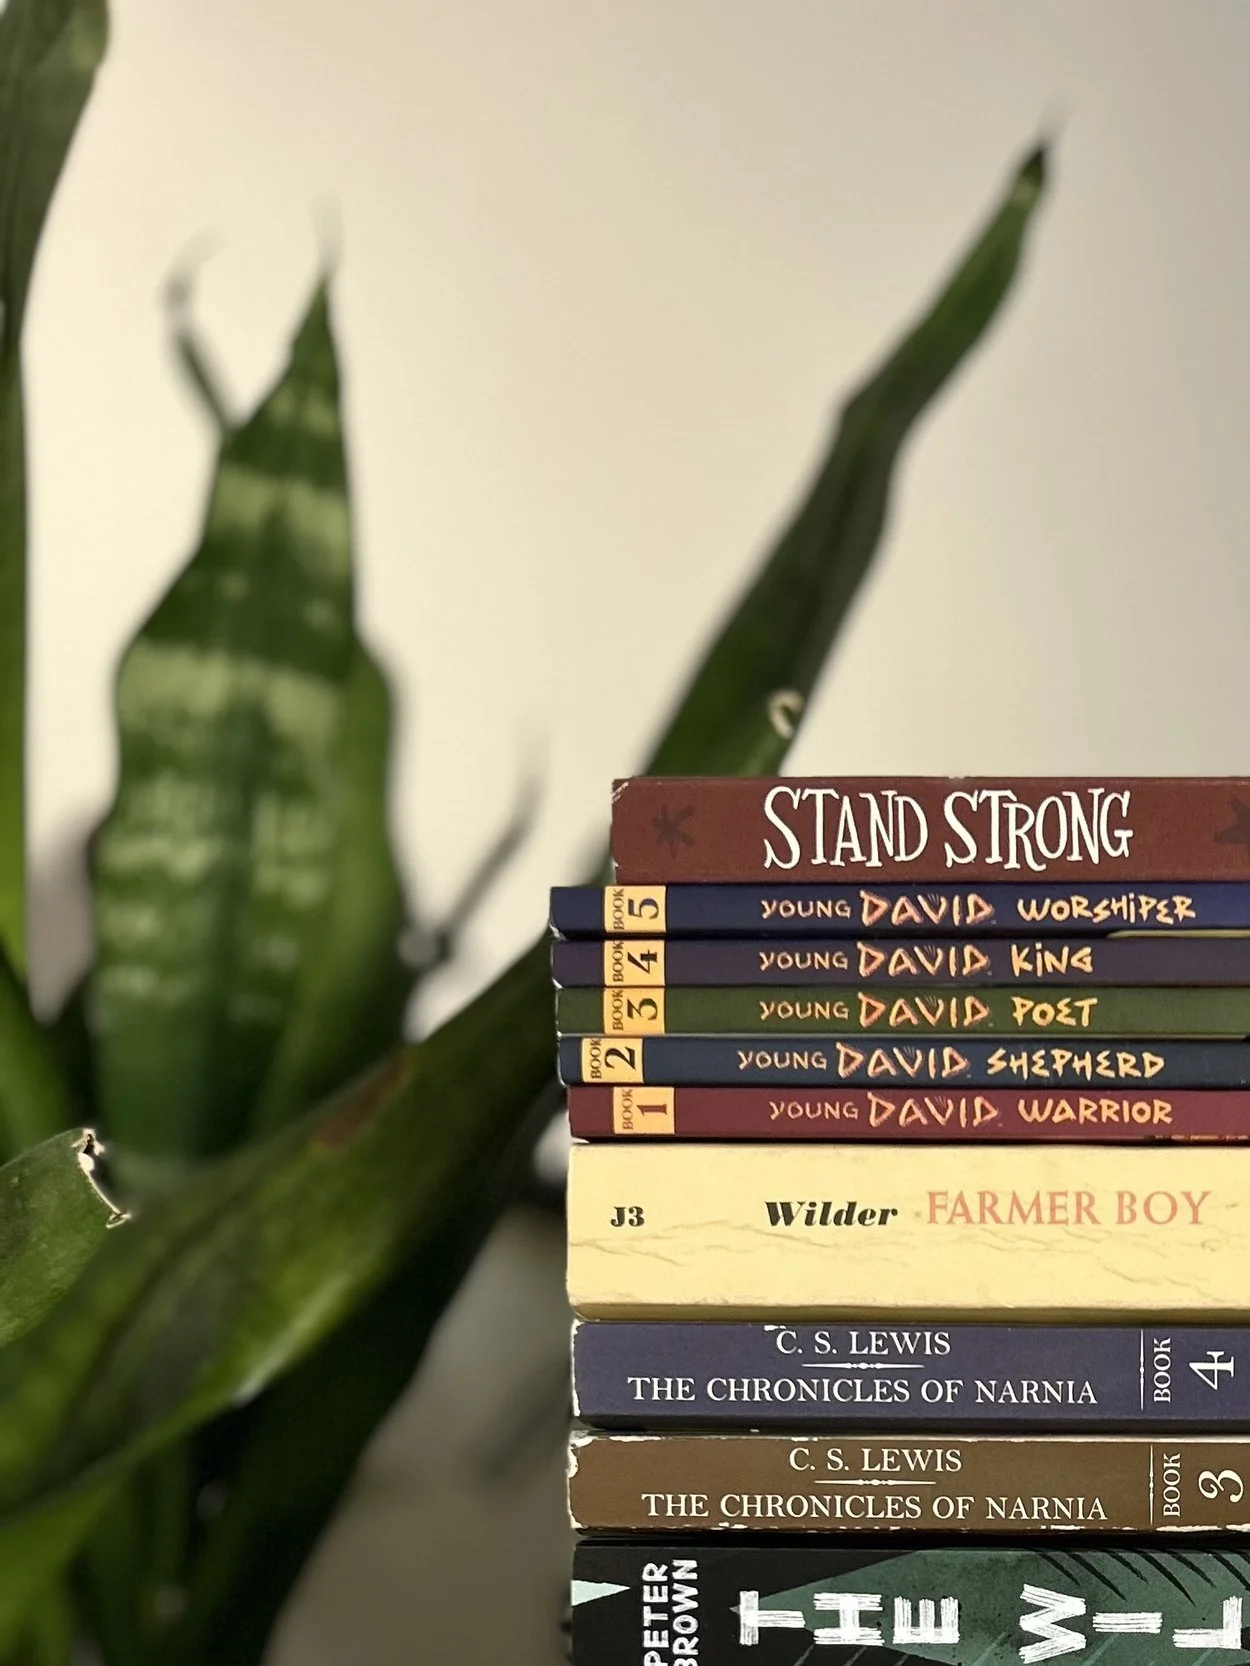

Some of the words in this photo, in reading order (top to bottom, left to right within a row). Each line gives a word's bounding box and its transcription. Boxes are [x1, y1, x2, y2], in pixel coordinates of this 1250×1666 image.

[764, 786, 927, 871] STAND
[945, 788, 1132, 872] STRONG
[613, 889, 625, 931] BOOK
[627, 898, 660, 920] 5
[761, 900, 851, 920] YOUNG
[859, 890, 993, 927] DAVID
[613, 941, 625, 983] BOOK
[627, 948, 659, 971] 4
[613, 990, 625, 1031] BOOK
[627, 998, 658, 1021] 3
[1012, 996, 1098, 1028] POET
[605, 1046, 636, 1071] 2
[738, 1051, 827, 1072] YOUNG
[836, 1042, 968, 1079] DAVID
[987, 1048, 1164, 1081] SHEPHERD
[622, 1089, 634, 1130] BOOK
[636, 1102, 668, 1117] 1
[769, 1101, 859, 1122] YOUNG
[868, 1092, 998, 1128] DAVID
[1018, 1098, 1173, 1127] WARRIOR
[610, 1206, 645, 1228] J3
[765, 1201, 898, 1227] Wilder
[926, 1191, 1100, 1224] FARMER
[1116, 1191, 1212, 1225] BOY
[850, 1332, 951, 1355] LEWIS
[1154, 1338, 1171, 1403] BOOK
[1189, 1349, 1235, 1391] 4
[628, 1376, 695, 1401] THE
[706, 1376, 910, 1403] CHRONICLES
[921, 1379, 964, 1402] OF
[975, 1380, 1098, 1404] NARNIA
[861, 1448, 962, 1472] LEWIS
[1163, 1453, 1181, 1517] BOOK
[1201, 1469, 1244, 1502] 3
[642, 1493, 708, 1518] THE
[720, 1493, 922, 1520] CHRONICLES
[933, 1496, 974, 1519] OF
[985, 1497, 1108, 1521] NARNIA
[739, 1590, 959, 1646] THE
